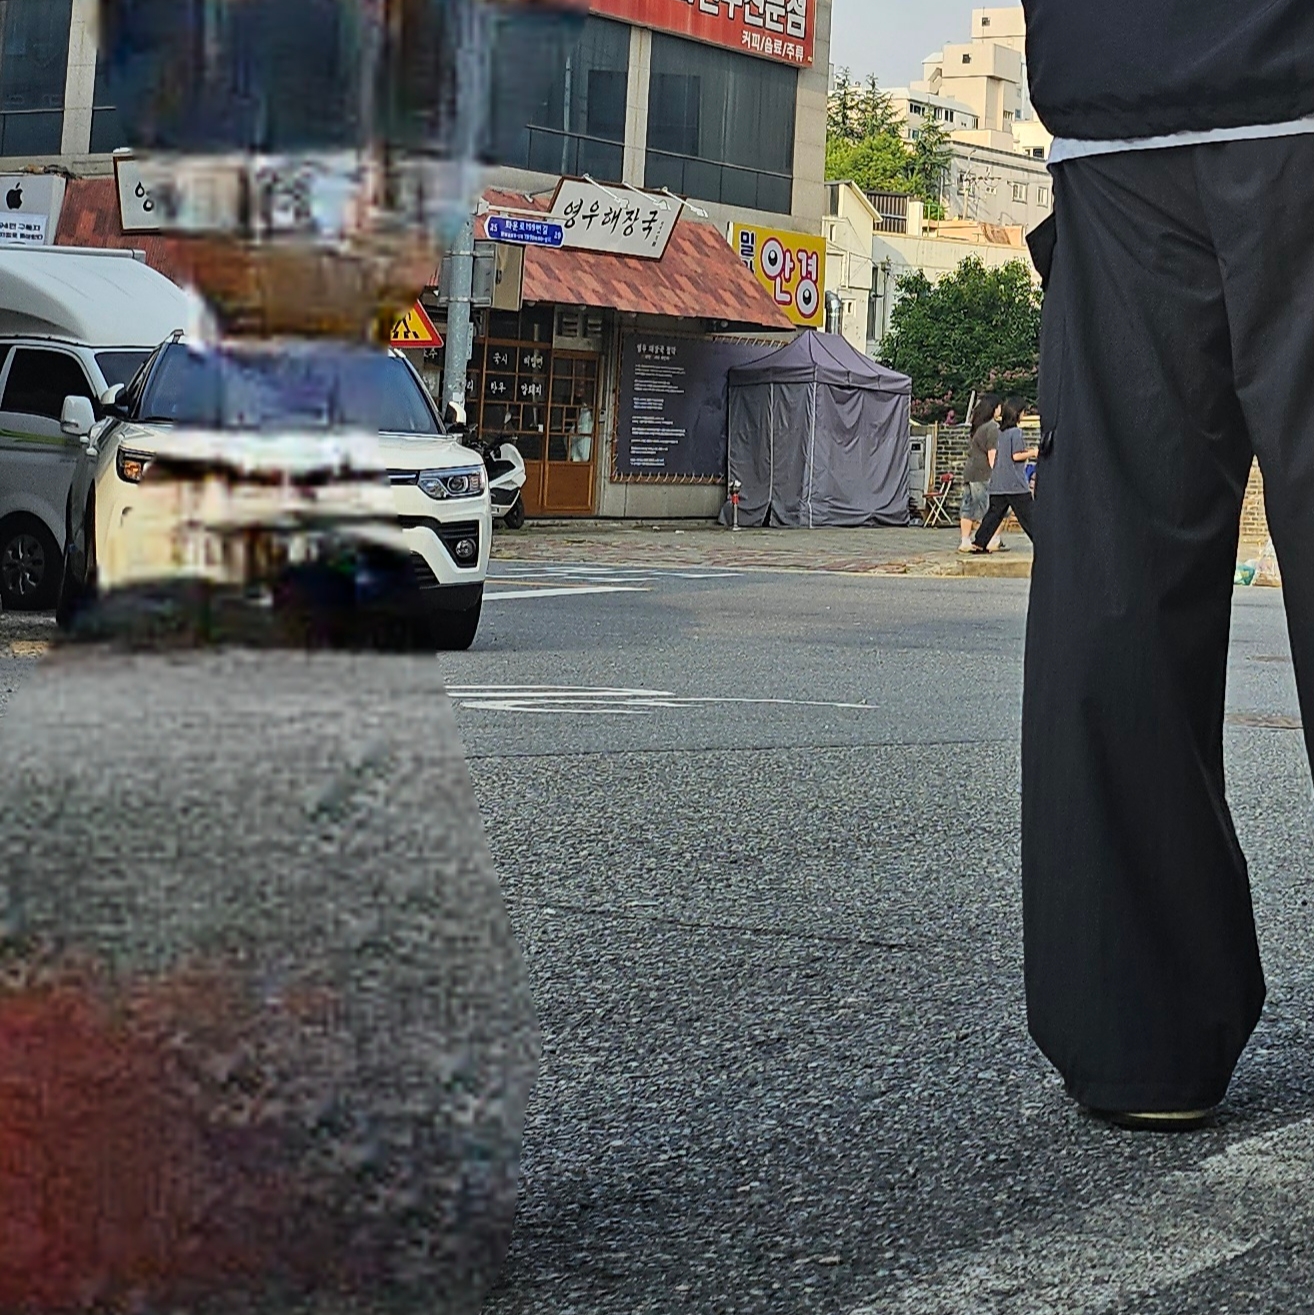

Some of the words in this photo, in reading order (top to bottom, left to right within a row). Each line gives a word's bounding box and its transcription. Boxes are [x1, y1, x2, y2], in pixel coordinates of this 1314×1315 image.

[741, 29, 805, 63] 커피/음료/주류
[563, 198, 659, 241] 영우해장국
[761, 237, 820, 320] 안경
